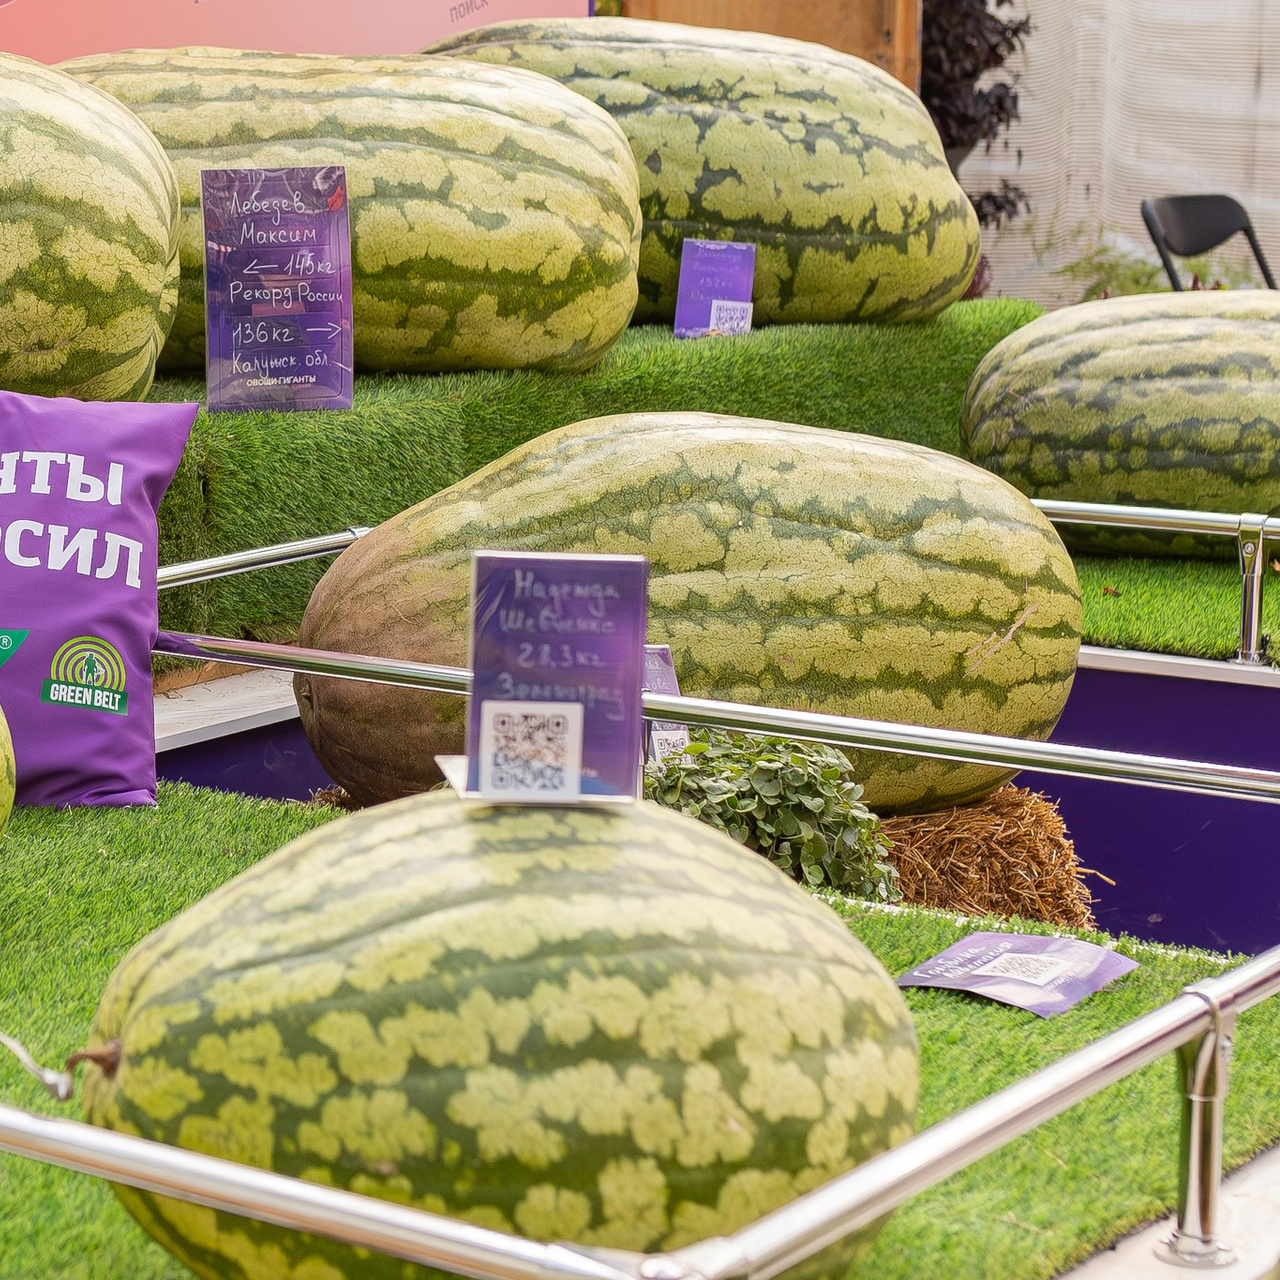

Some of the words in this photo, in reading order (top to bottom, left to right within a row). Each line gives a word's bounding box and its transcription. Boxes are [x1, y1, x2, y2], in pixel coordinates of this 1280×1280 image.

[231, 191, 306, 226] Лебедев
[240, 222, 317, 245] Максим
[230, 281, 293, 309] Рекорд
[298, 282, 344, 304] России
[246, 374, 317, 387] ОВОЩИ-ГИГАНТЫ
[49, 683, 93, 706] GREEN
[93, 691, 122, 711] BELT
